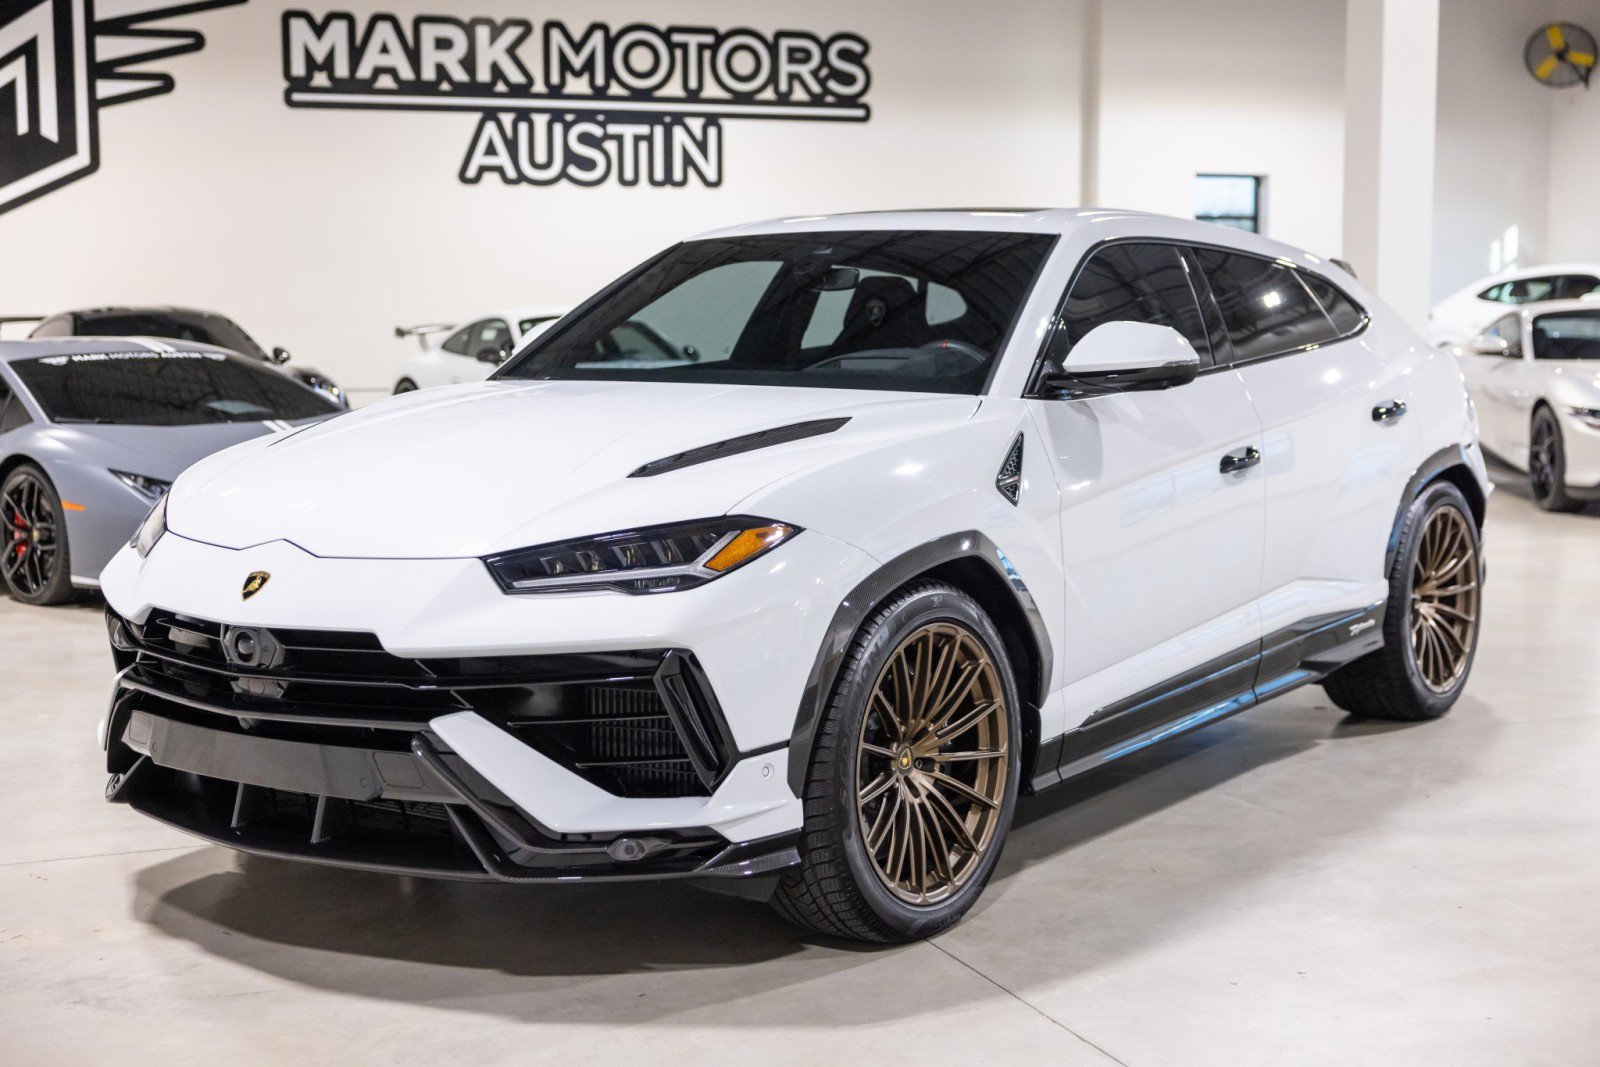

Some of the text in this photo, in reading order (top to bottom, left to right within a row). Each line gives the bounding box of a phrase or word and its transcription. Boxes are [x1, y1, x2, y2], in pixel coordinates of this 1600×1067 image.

[286, 15, 868, 97] MARK MOTORS
[463, 118, 720, 184] AUSTIN
